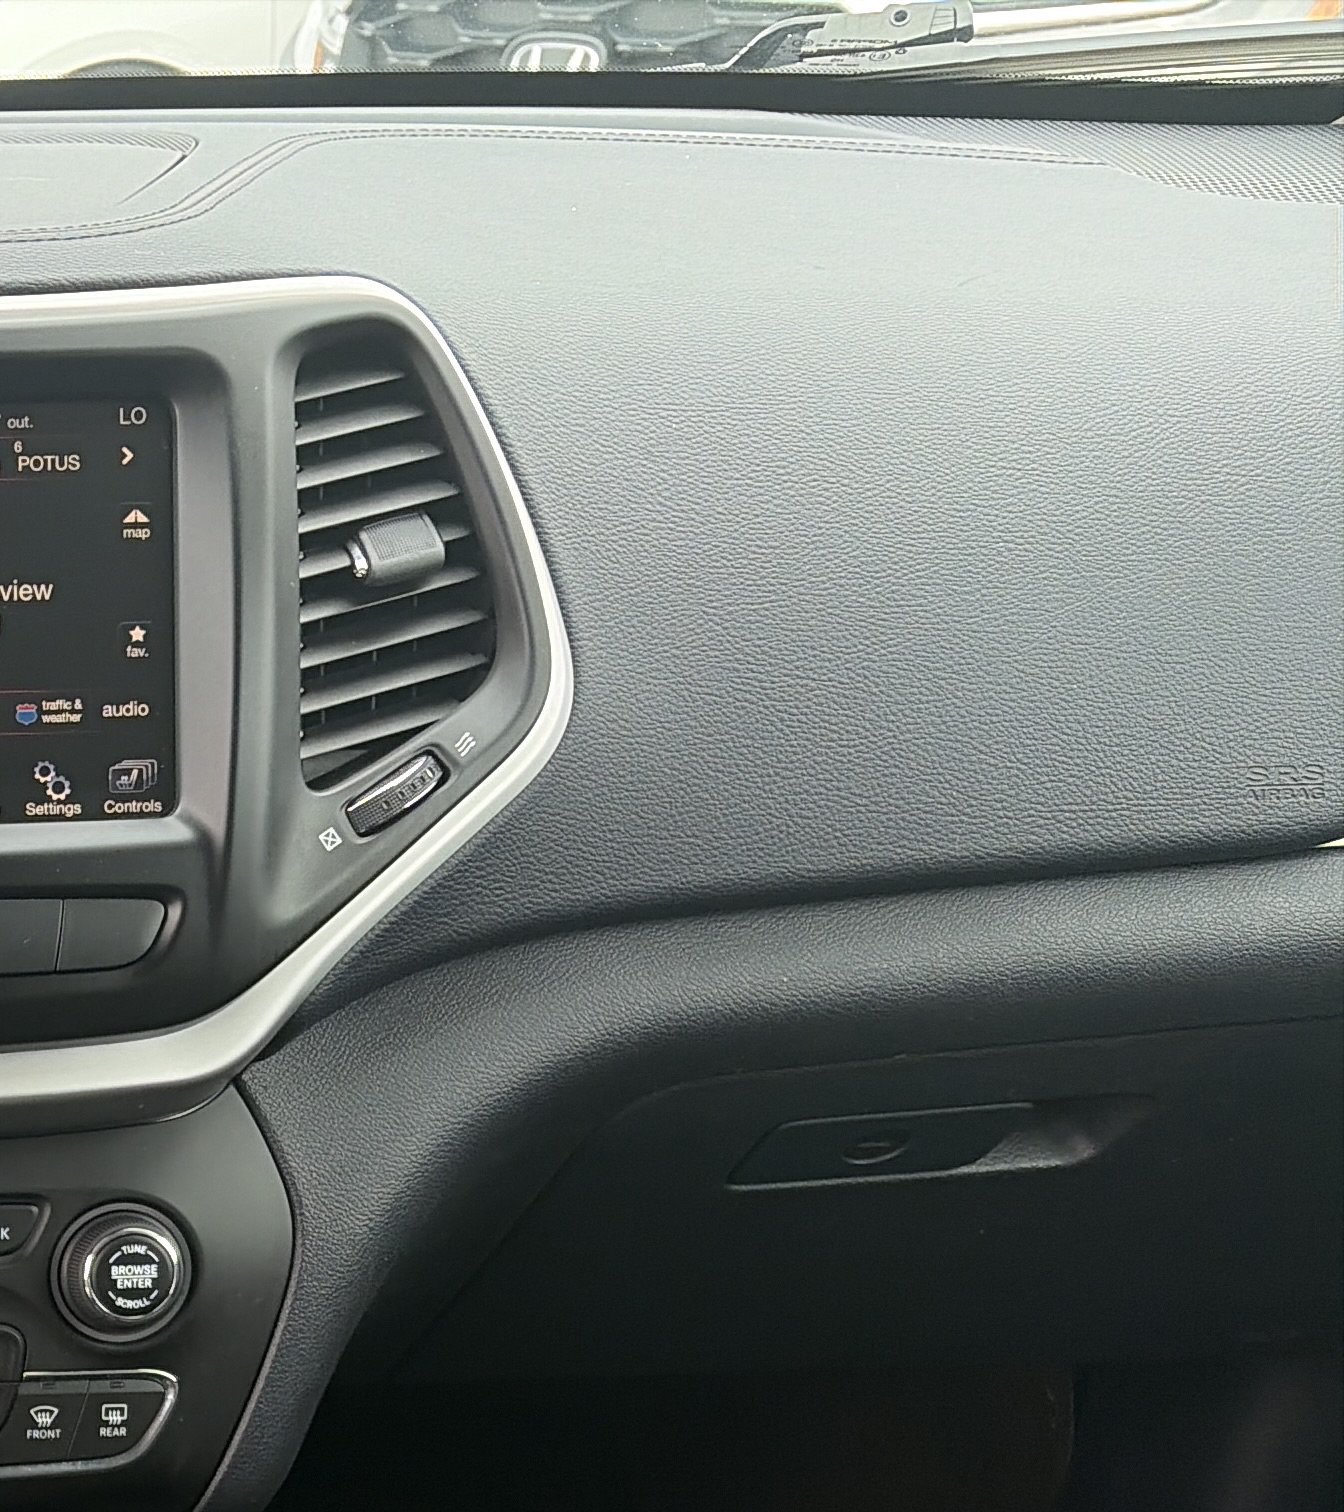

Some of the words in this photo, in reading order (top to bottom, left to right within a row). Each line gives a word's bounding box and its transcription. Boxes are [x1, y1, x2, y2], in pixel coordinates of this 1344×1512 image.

[7, 416, 34, 429] out.
[119, 407, 147, 425] LO
[14, 441, 23, 453] 6
[17, 455, 81, 472] POTUS
[123, 527, 151, 540] map
[126, 645, 150, 658] fav.
[41, 699, 73, 711] traffic
[74, 699, 83, 710] &
[102, 701, 150, 718] audio
[41, 711, 82, 724] weather
[1245, 763, 1325, 782] SRS
[25, 802, 83, 817] Settings
[103, 800, 163, 814] Controls
[120, 1243, 148, 1255] TUNE
[110, 1263, 159, 1276] BROWSE
[116, 1278, 153, 1289] ENTER
[115, 1296, 151, 1309] SCROLL
[26, 1428, 61, 1440] FRONT
[99, 1425, 127, 1437] REAR
